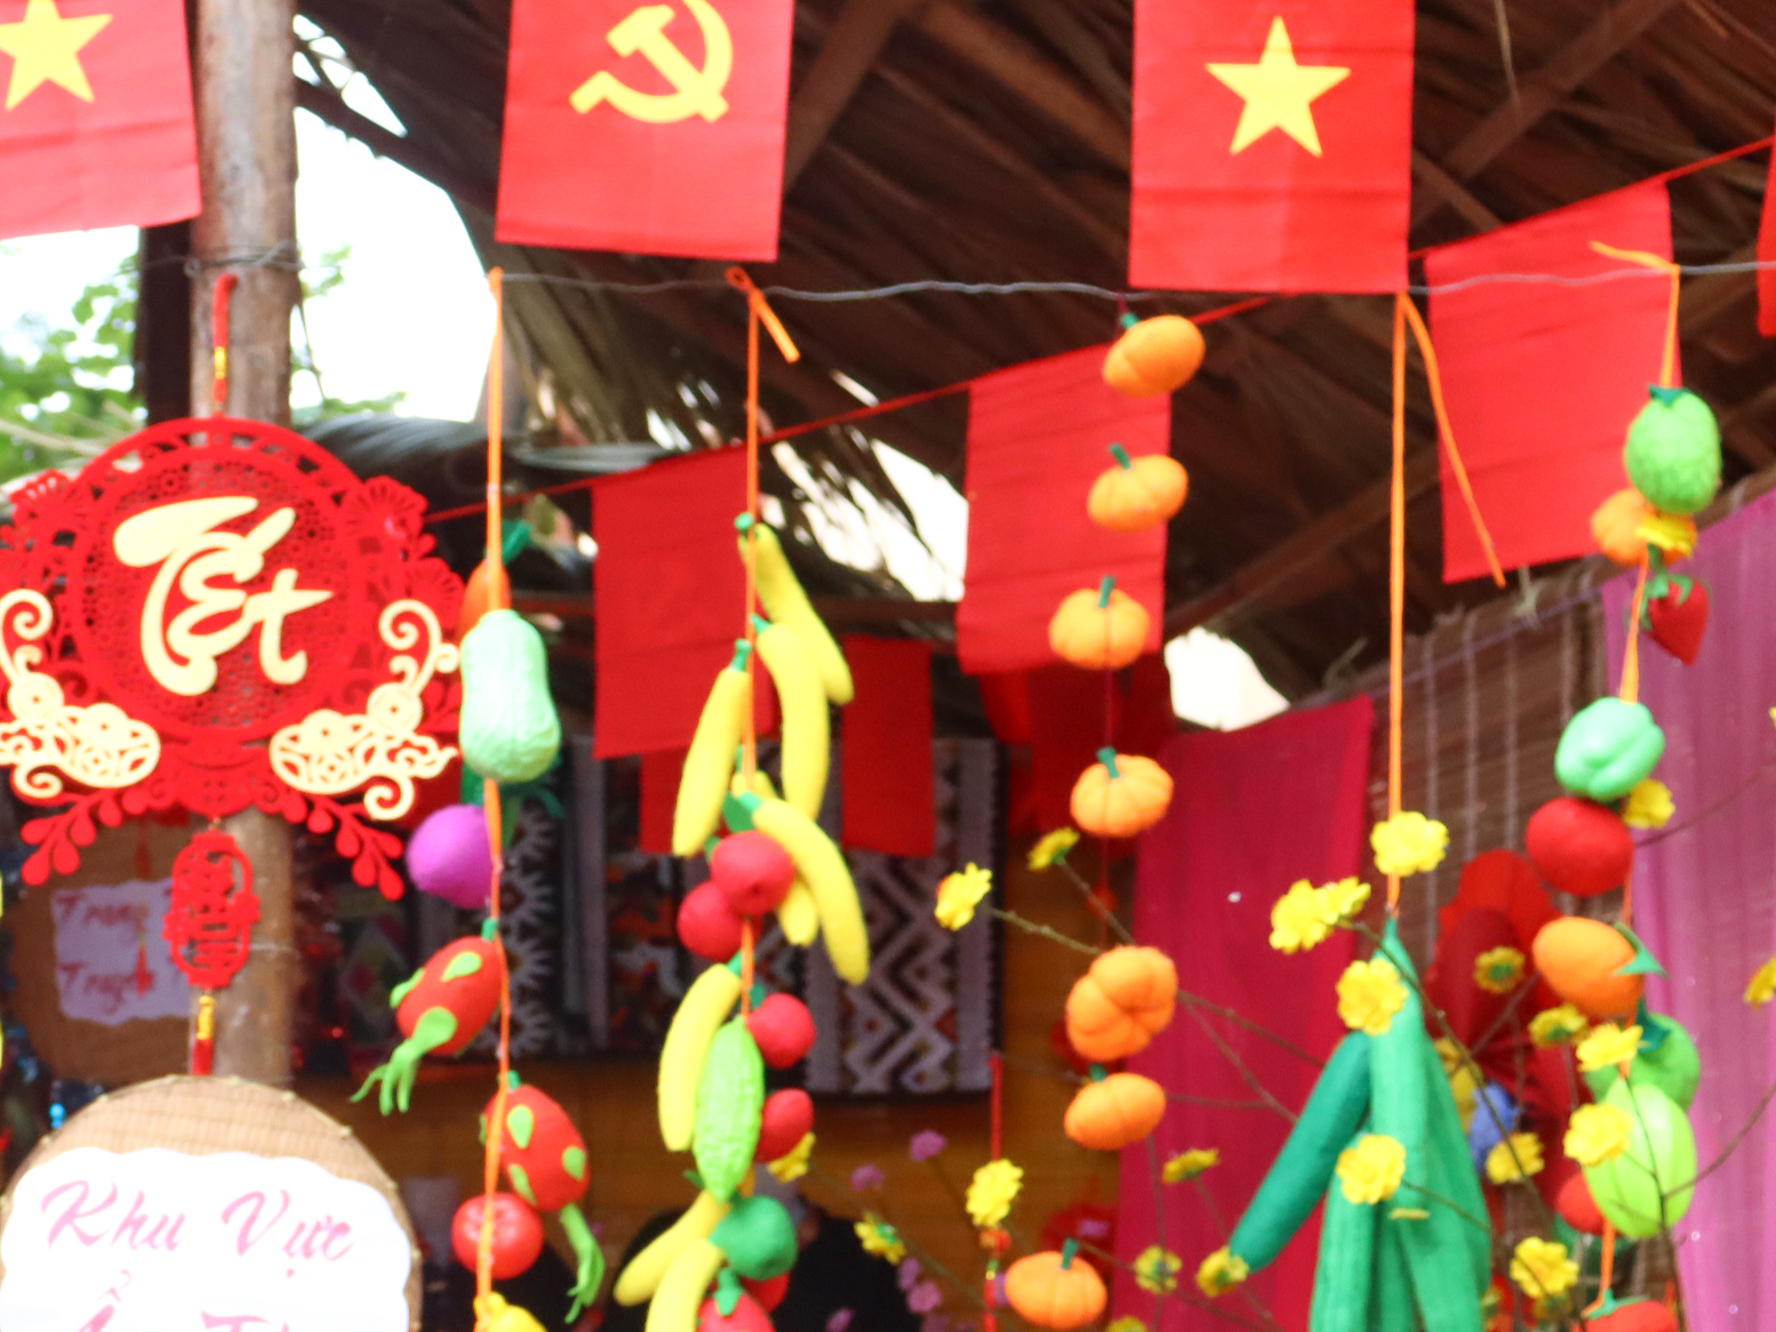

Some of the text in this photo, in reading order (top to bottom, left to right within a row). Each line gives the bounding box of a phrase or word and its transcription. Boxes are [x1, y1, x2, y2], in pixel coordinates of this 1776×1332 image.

[113, 496, 333, 696] Tết
[40, 1180, 358, 1279] Khu Vực
